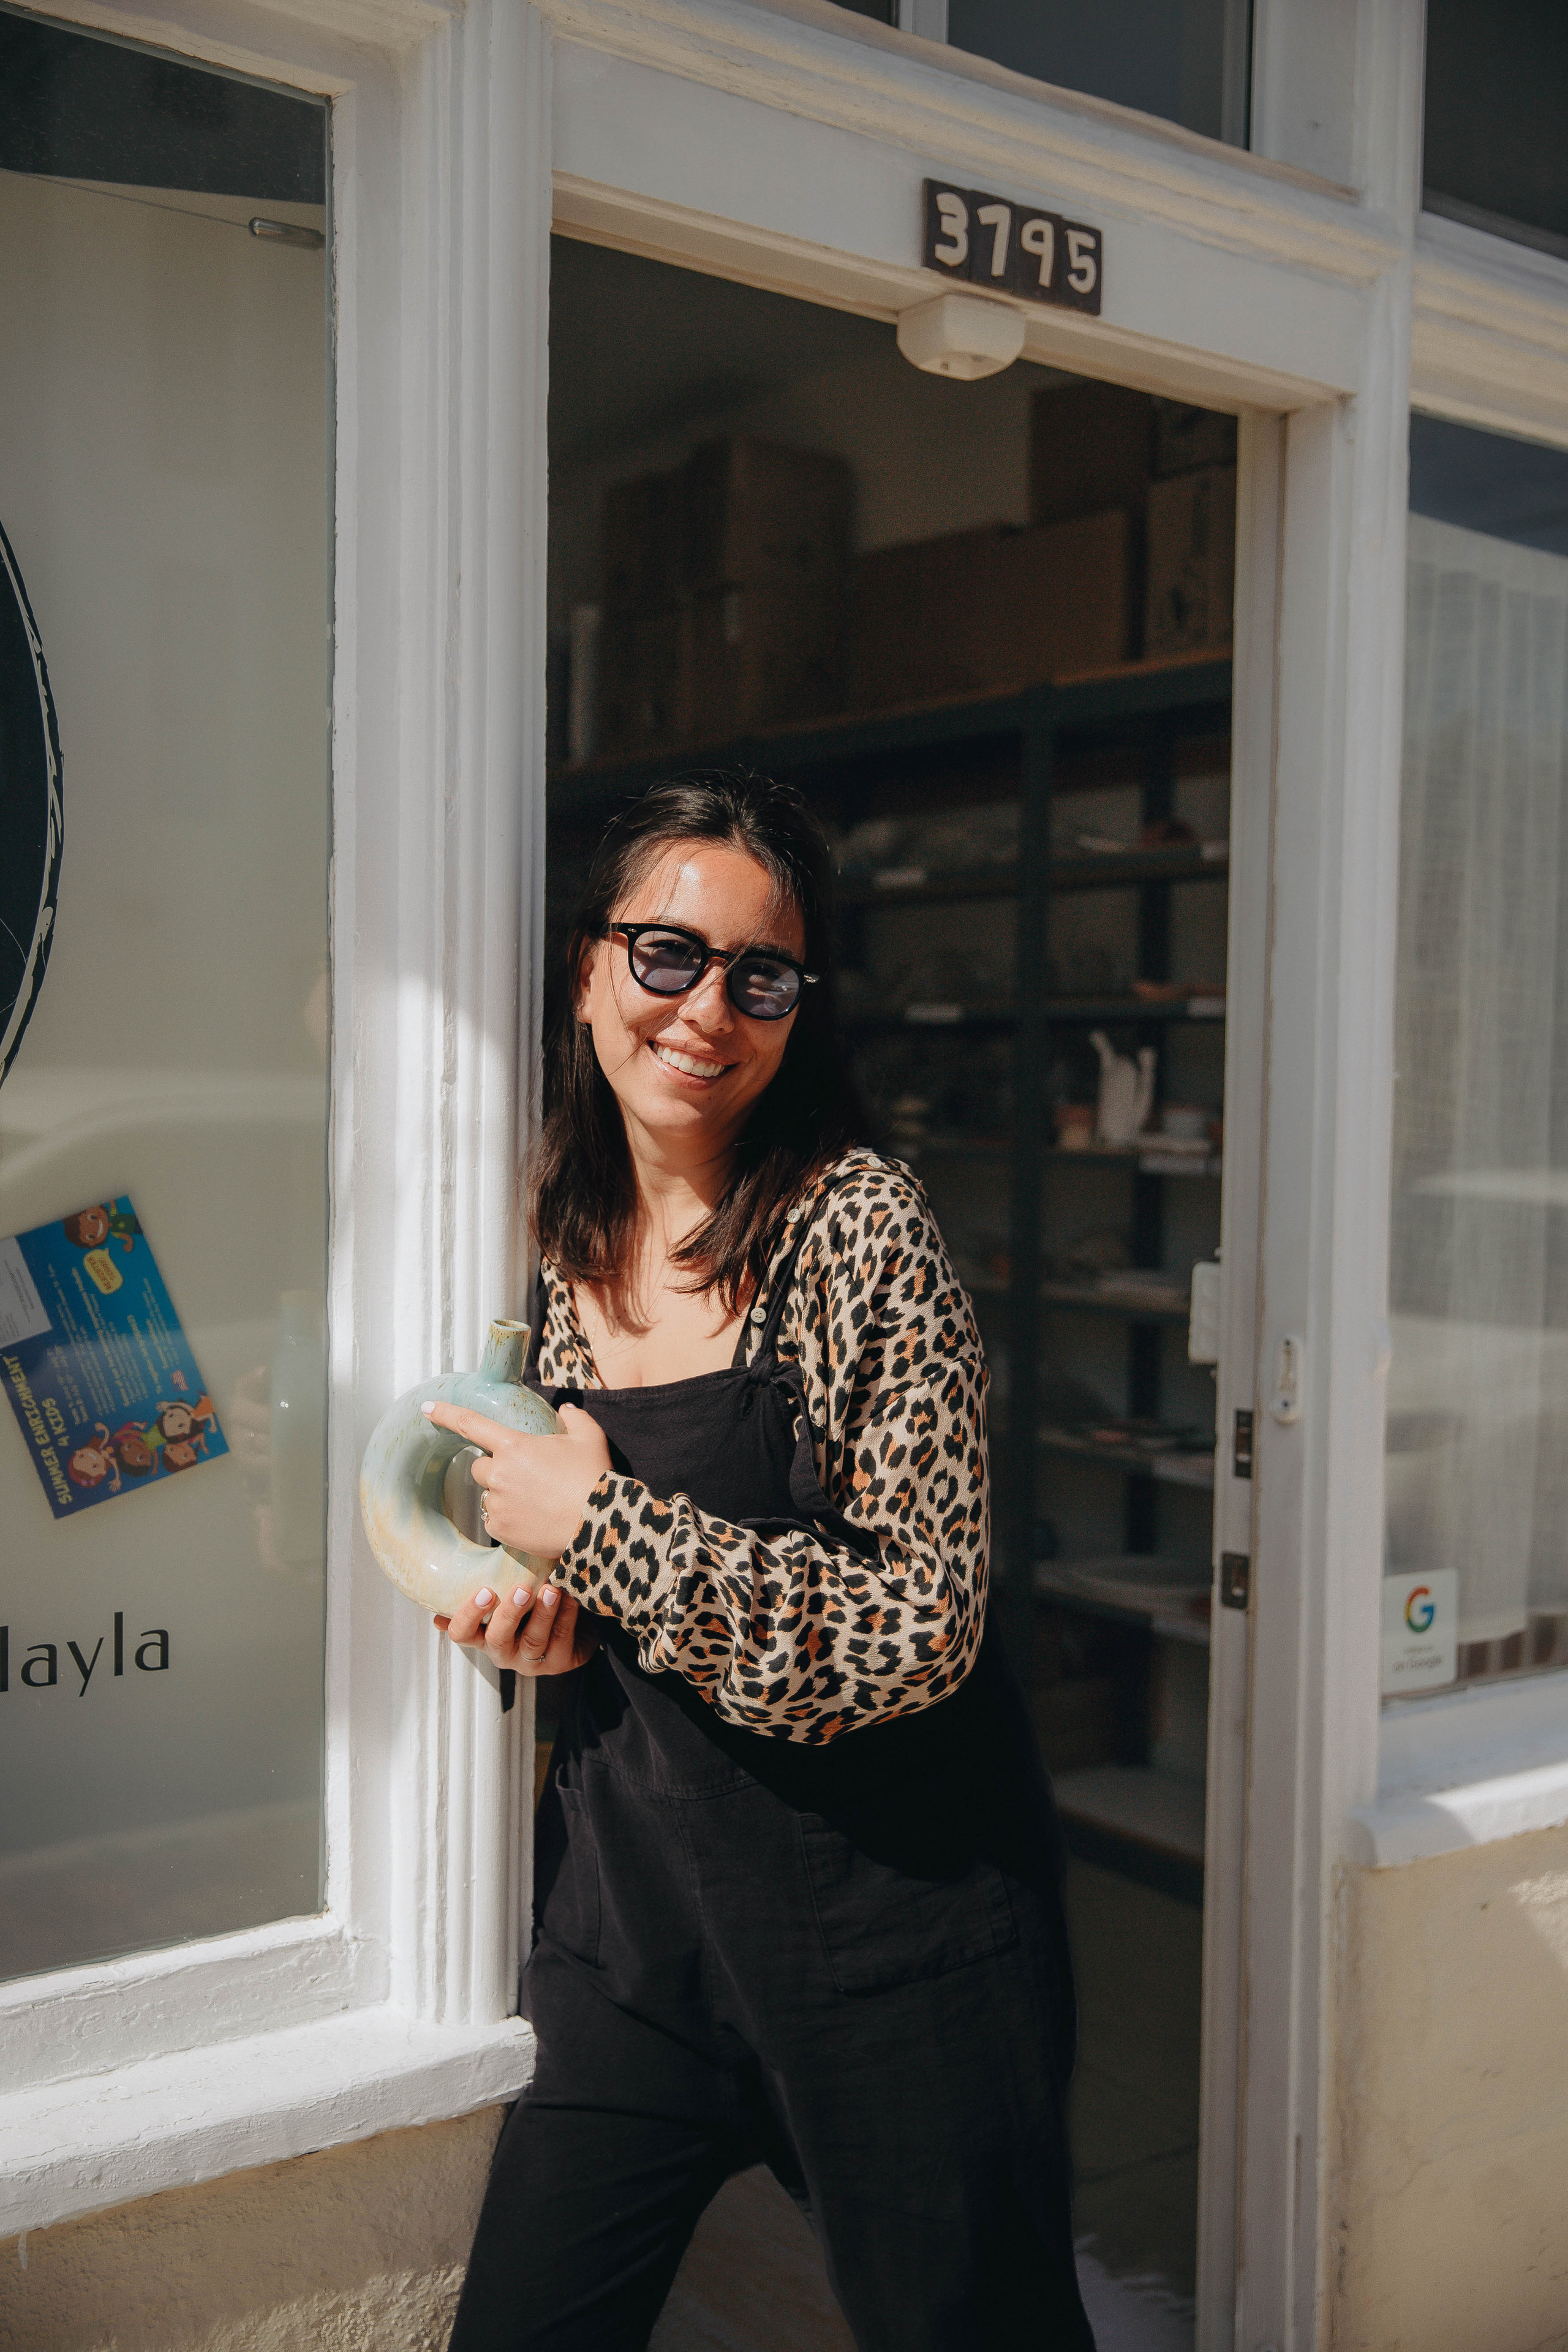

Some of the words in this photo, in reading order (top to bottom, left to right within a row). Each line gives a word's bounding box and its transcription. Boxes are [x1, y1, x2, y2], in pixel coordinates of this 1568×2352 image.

[935, 192, 1097, 294] 3795
[4, 1357, 50, 1445] ENRICHMENT
[42, 1398, 66, 1434] KIDS
[59, 1436, 68, 1446] 4
[41, 1446, 72, 1504] SUMMER
